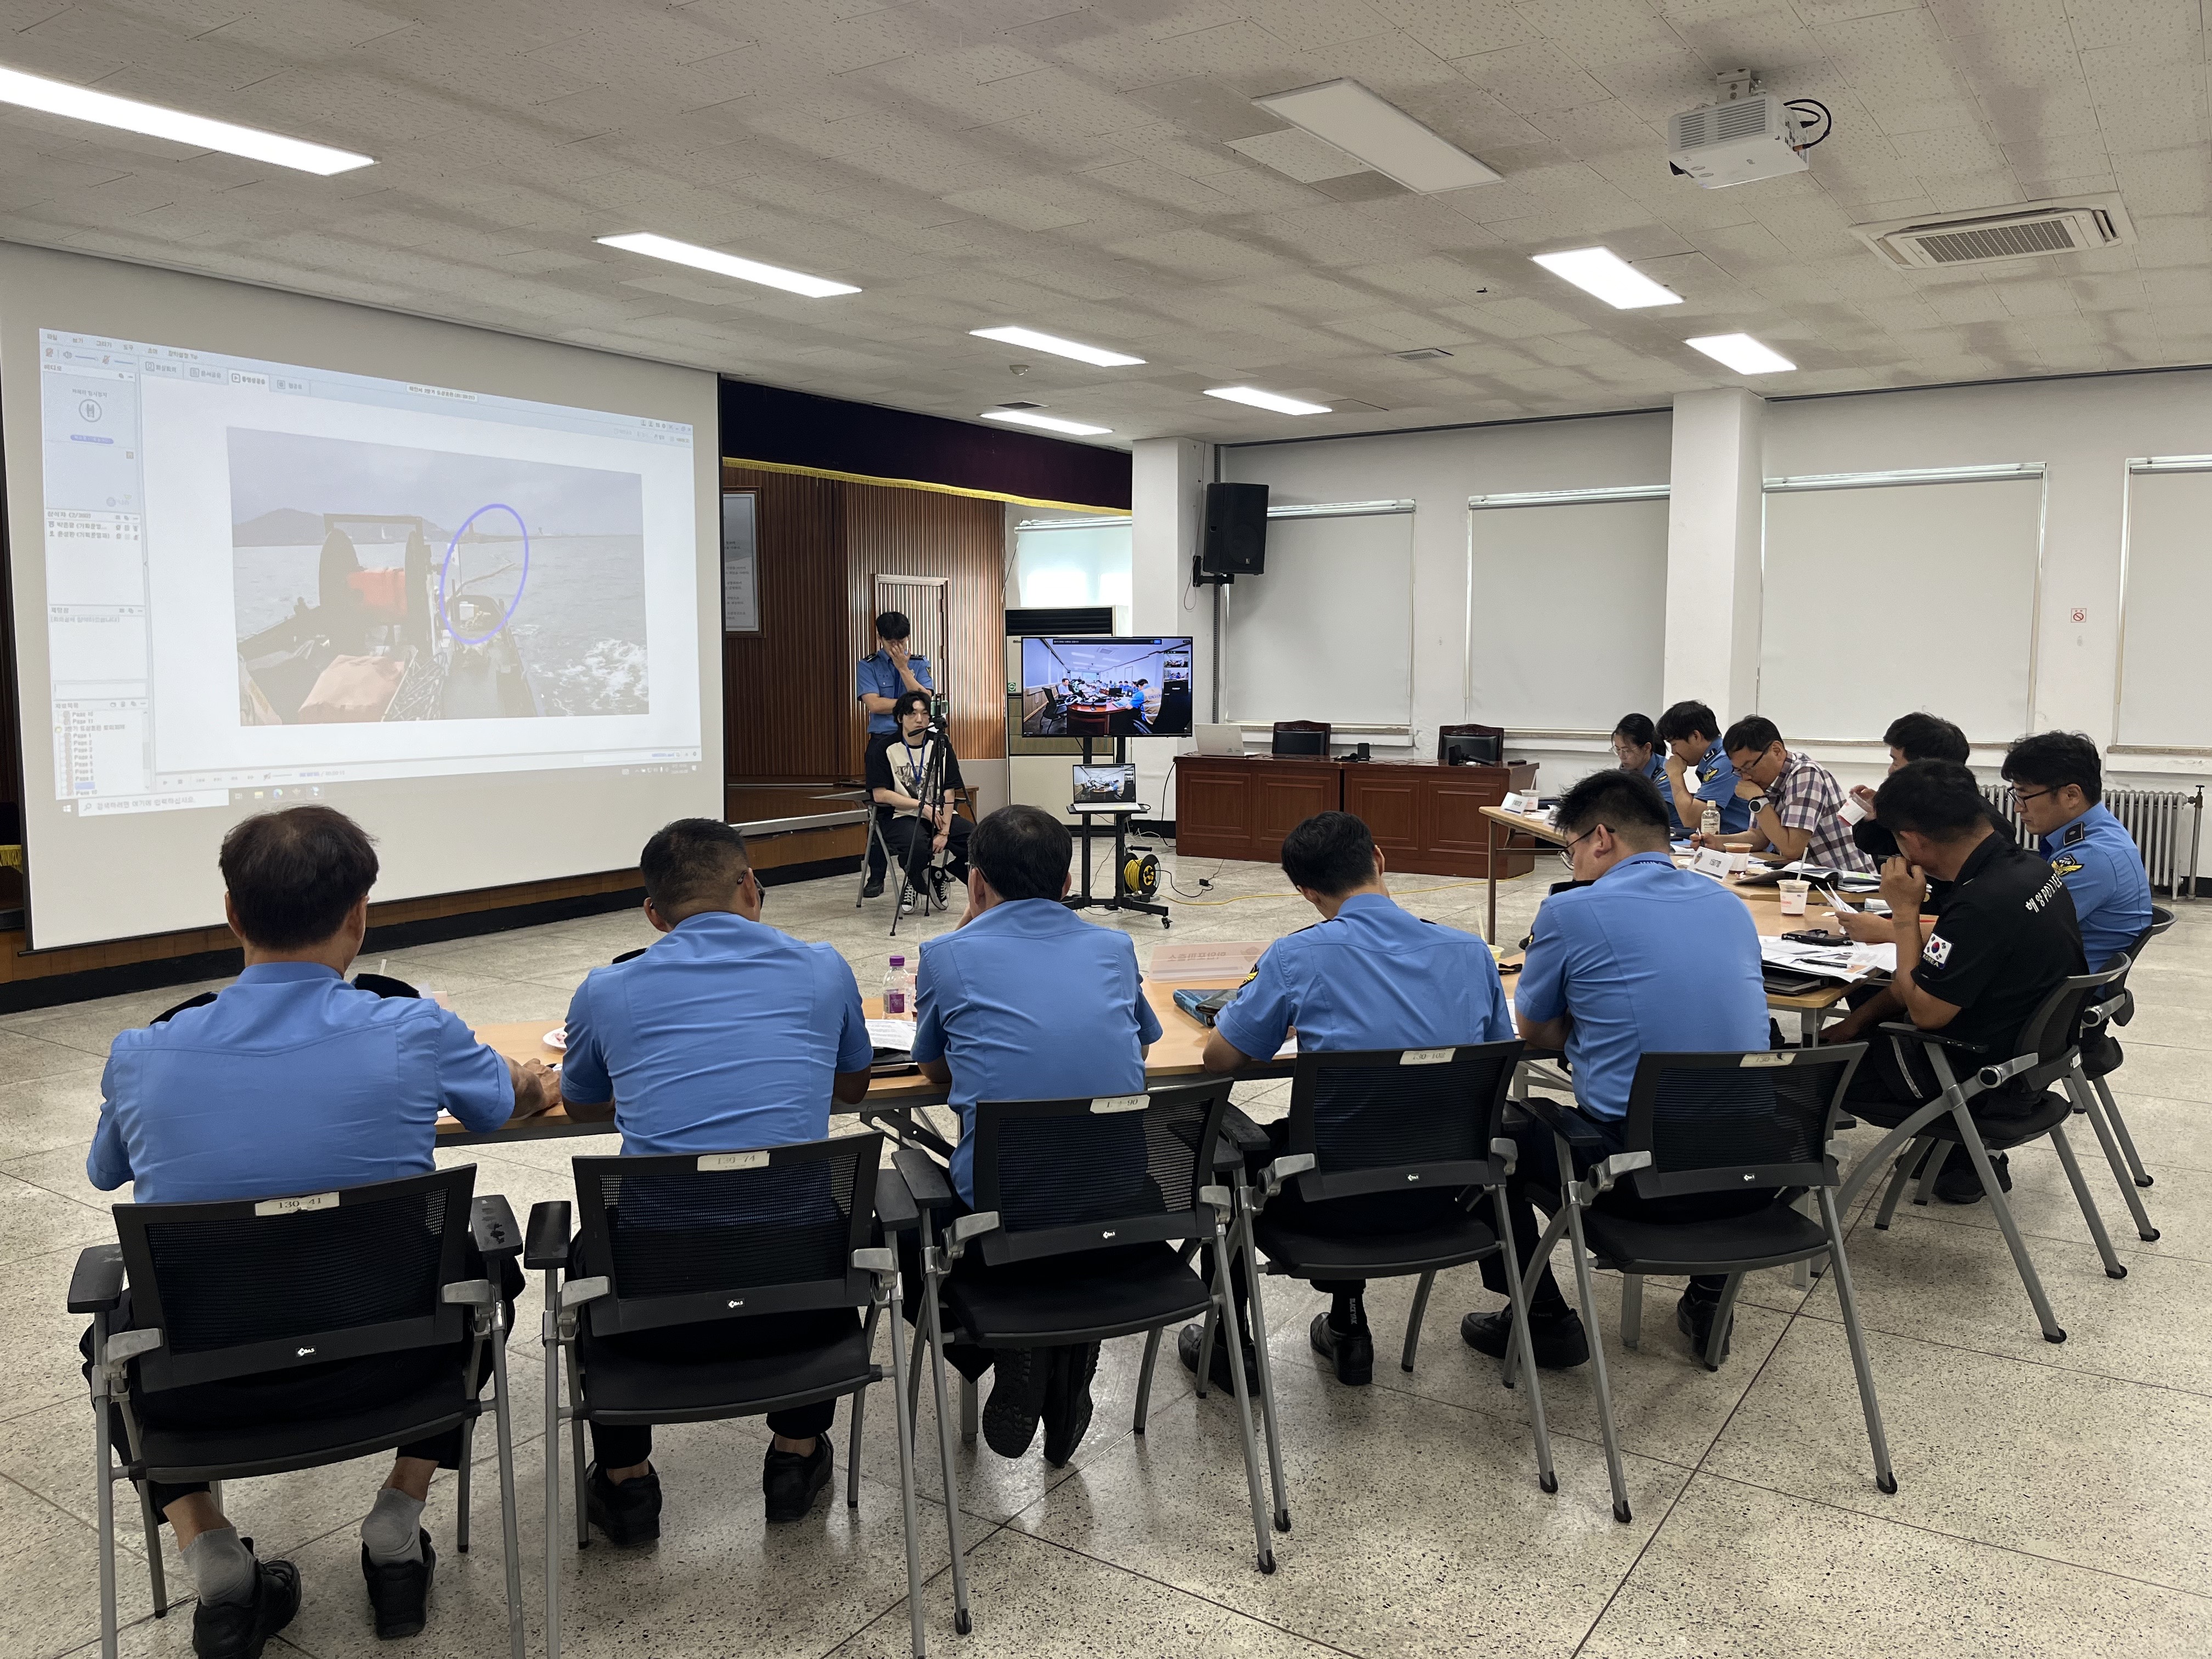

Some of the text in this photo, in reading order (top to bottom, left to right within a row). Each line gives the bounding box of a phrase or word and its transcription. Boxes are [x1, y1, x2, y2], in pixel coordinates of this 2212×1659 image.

[97, 801, 129, 810] 검색하려면
[132, 799, 151, 807] 여기에
[1922, 953, 1939, 967] KOREA
